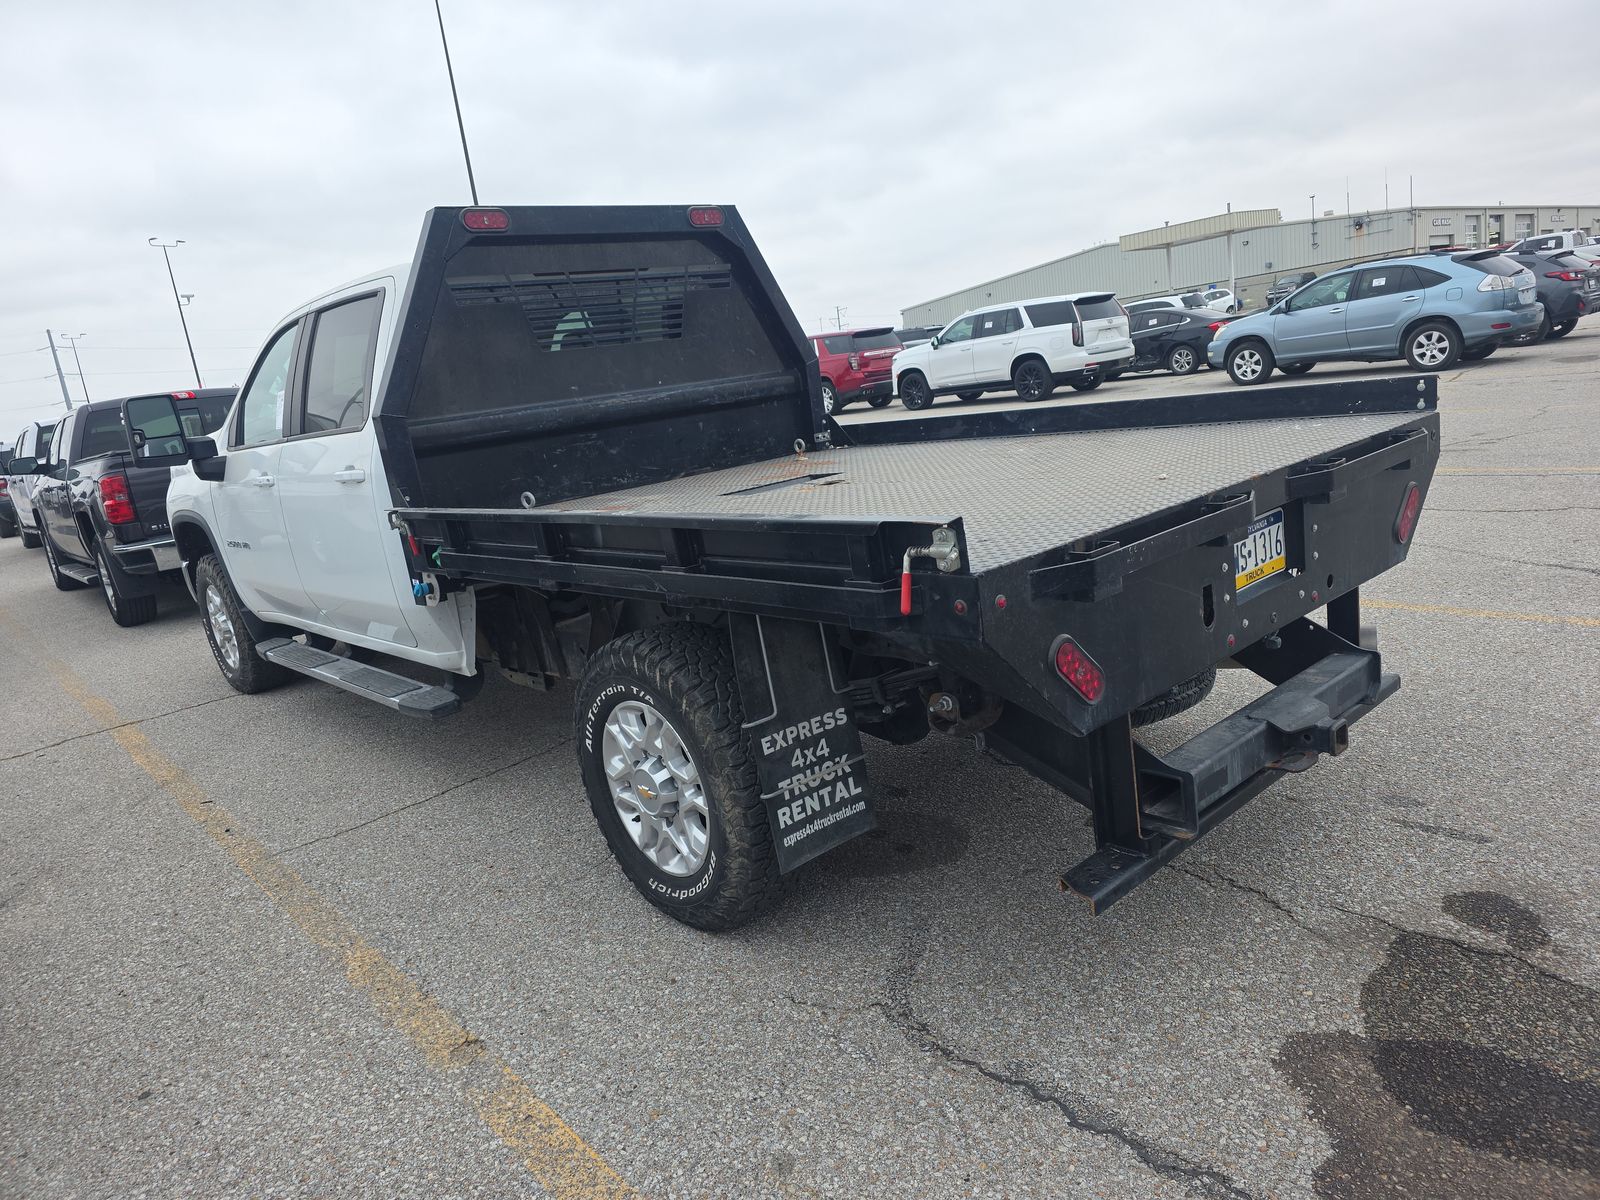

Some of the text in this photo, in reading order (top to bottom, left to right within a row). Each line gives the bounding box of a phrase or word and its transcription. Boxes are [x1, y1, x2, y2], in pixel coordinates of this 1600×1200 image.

[1245, 567, 1264, 582] TRUCK
[585, 684, 625, 752] All-Terrain
[761, 708, 847, 756] EXPRESS
[791, 738, 830, 768] 4x4
[778, 754, 852, 801] TRUCK
[777, 777, 862, 829] RENTAL
[783, 801, 866, 847] express4x4truckrental.com
[648, 850, 716, 900] BFGoodrich
